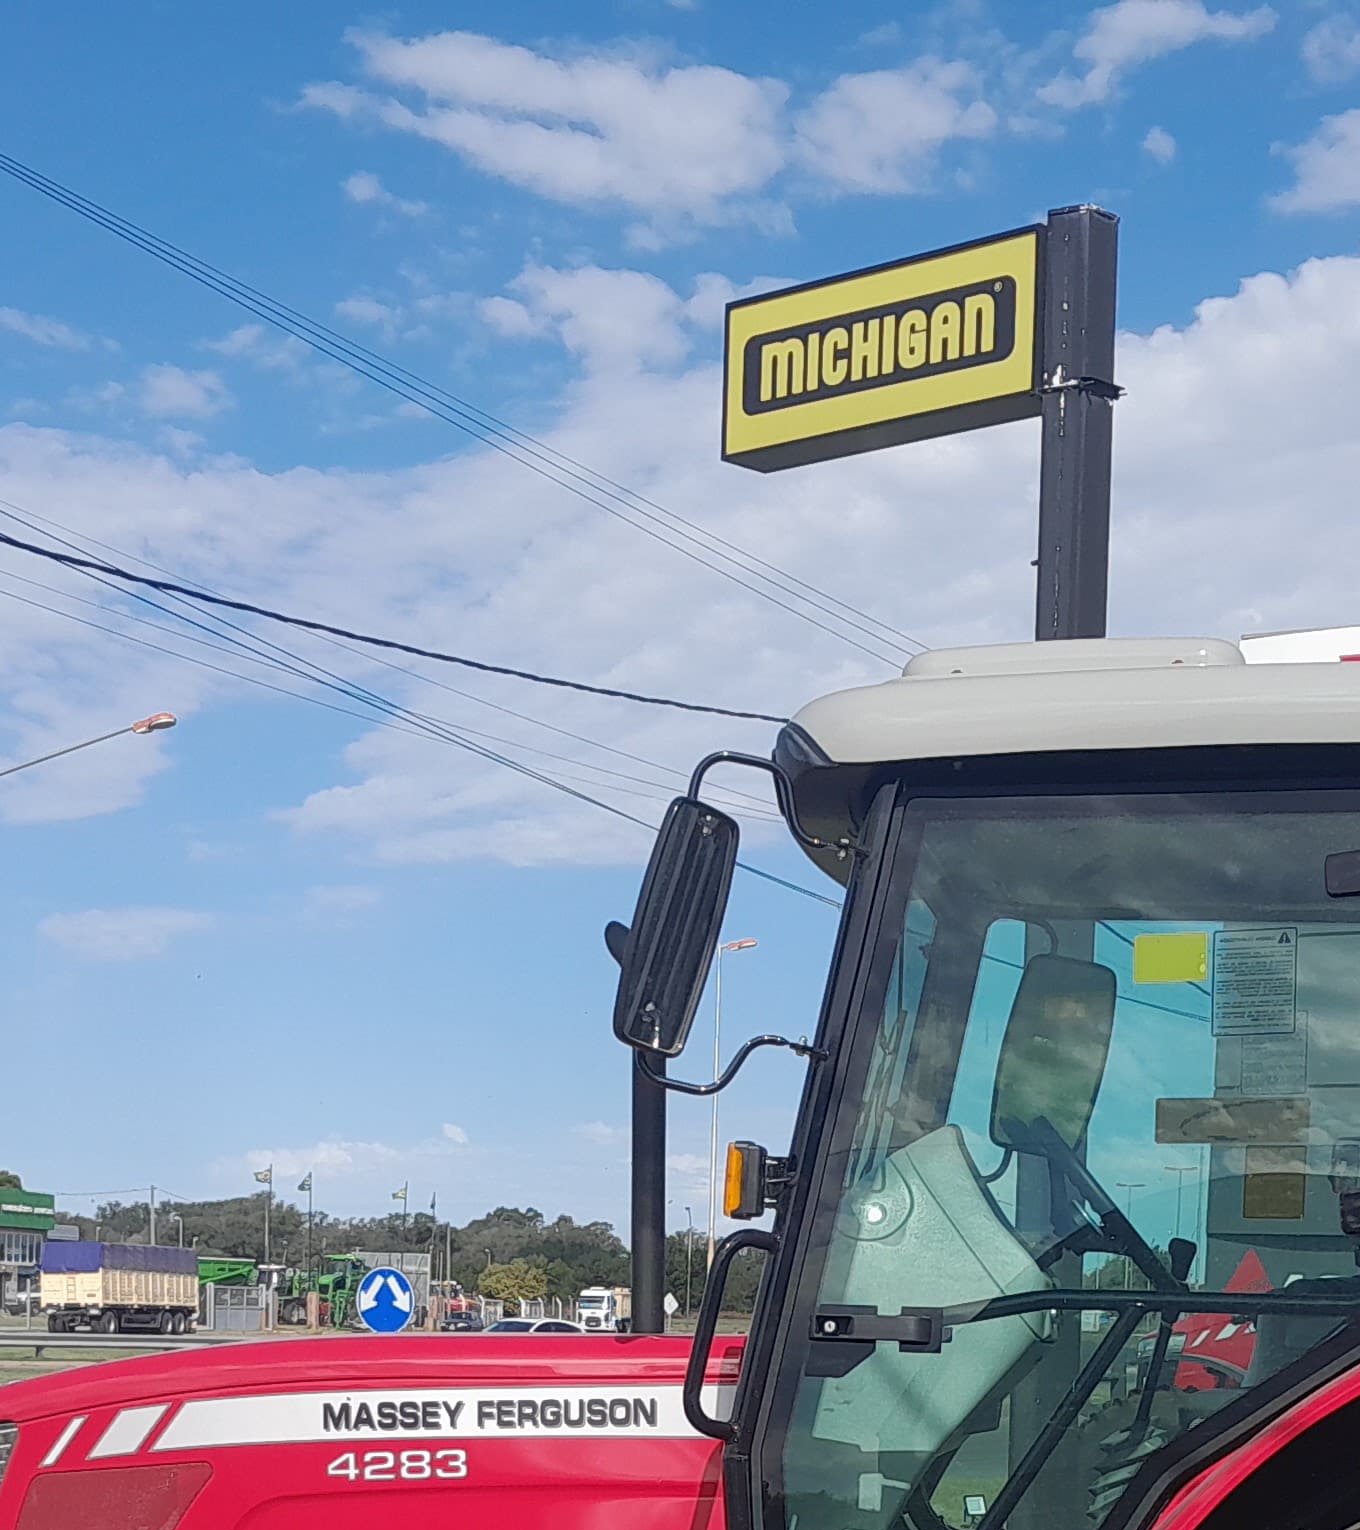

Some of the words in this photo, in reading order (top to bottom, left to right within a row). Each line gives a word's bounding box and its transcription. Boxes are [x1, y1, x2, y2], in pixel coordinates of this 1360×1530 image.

[759, 292, 996, 403] MICHIGAN
[322, 1400, 463, 1432] MASSEY
[477, 1398, 658, 1430] FERGUSON
[327, 1448, 469, 1481] 4283
